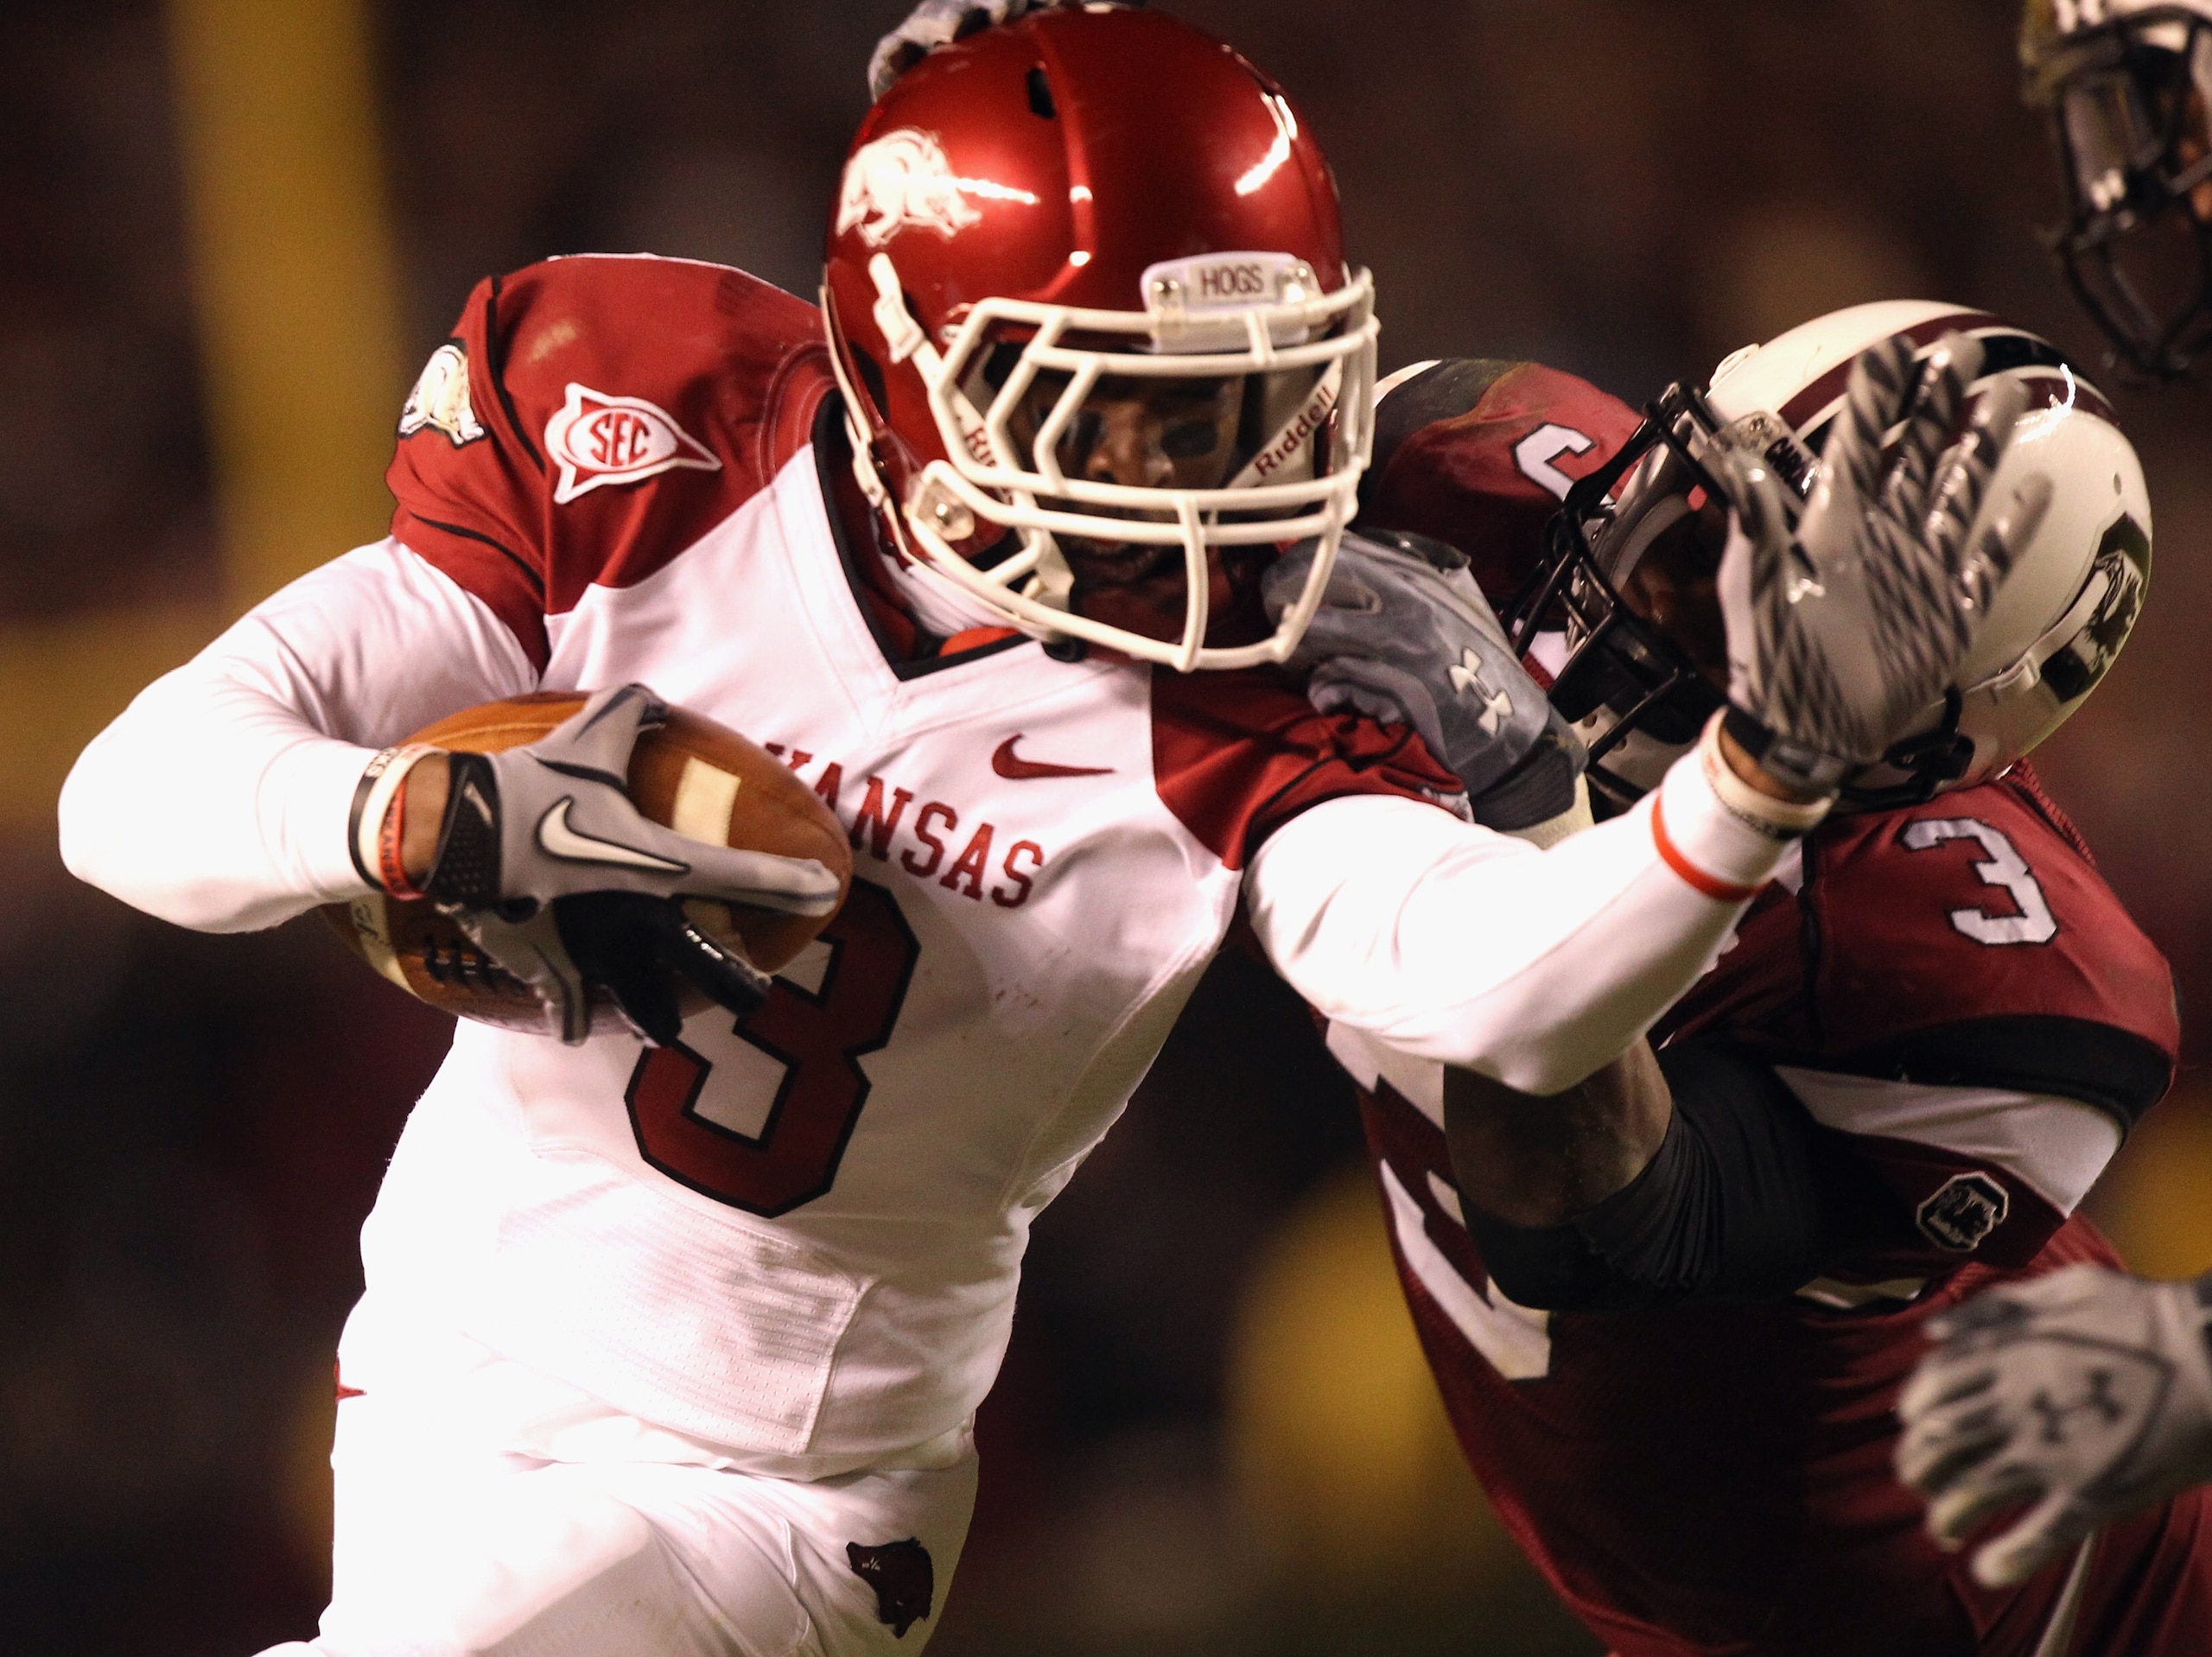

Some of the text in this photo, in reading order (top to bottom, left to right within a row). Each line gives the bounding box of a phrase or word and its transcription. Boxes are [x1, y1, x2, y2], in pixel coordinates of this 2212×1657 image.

[1198, 263, 1265, 297] HOGS
[589, 412, 650, 467] SEC
[1255, 384, 1334, 477] Riddell
[1899, 817, 2060, 945] 3
[625, 875, 921, 1219] 3
